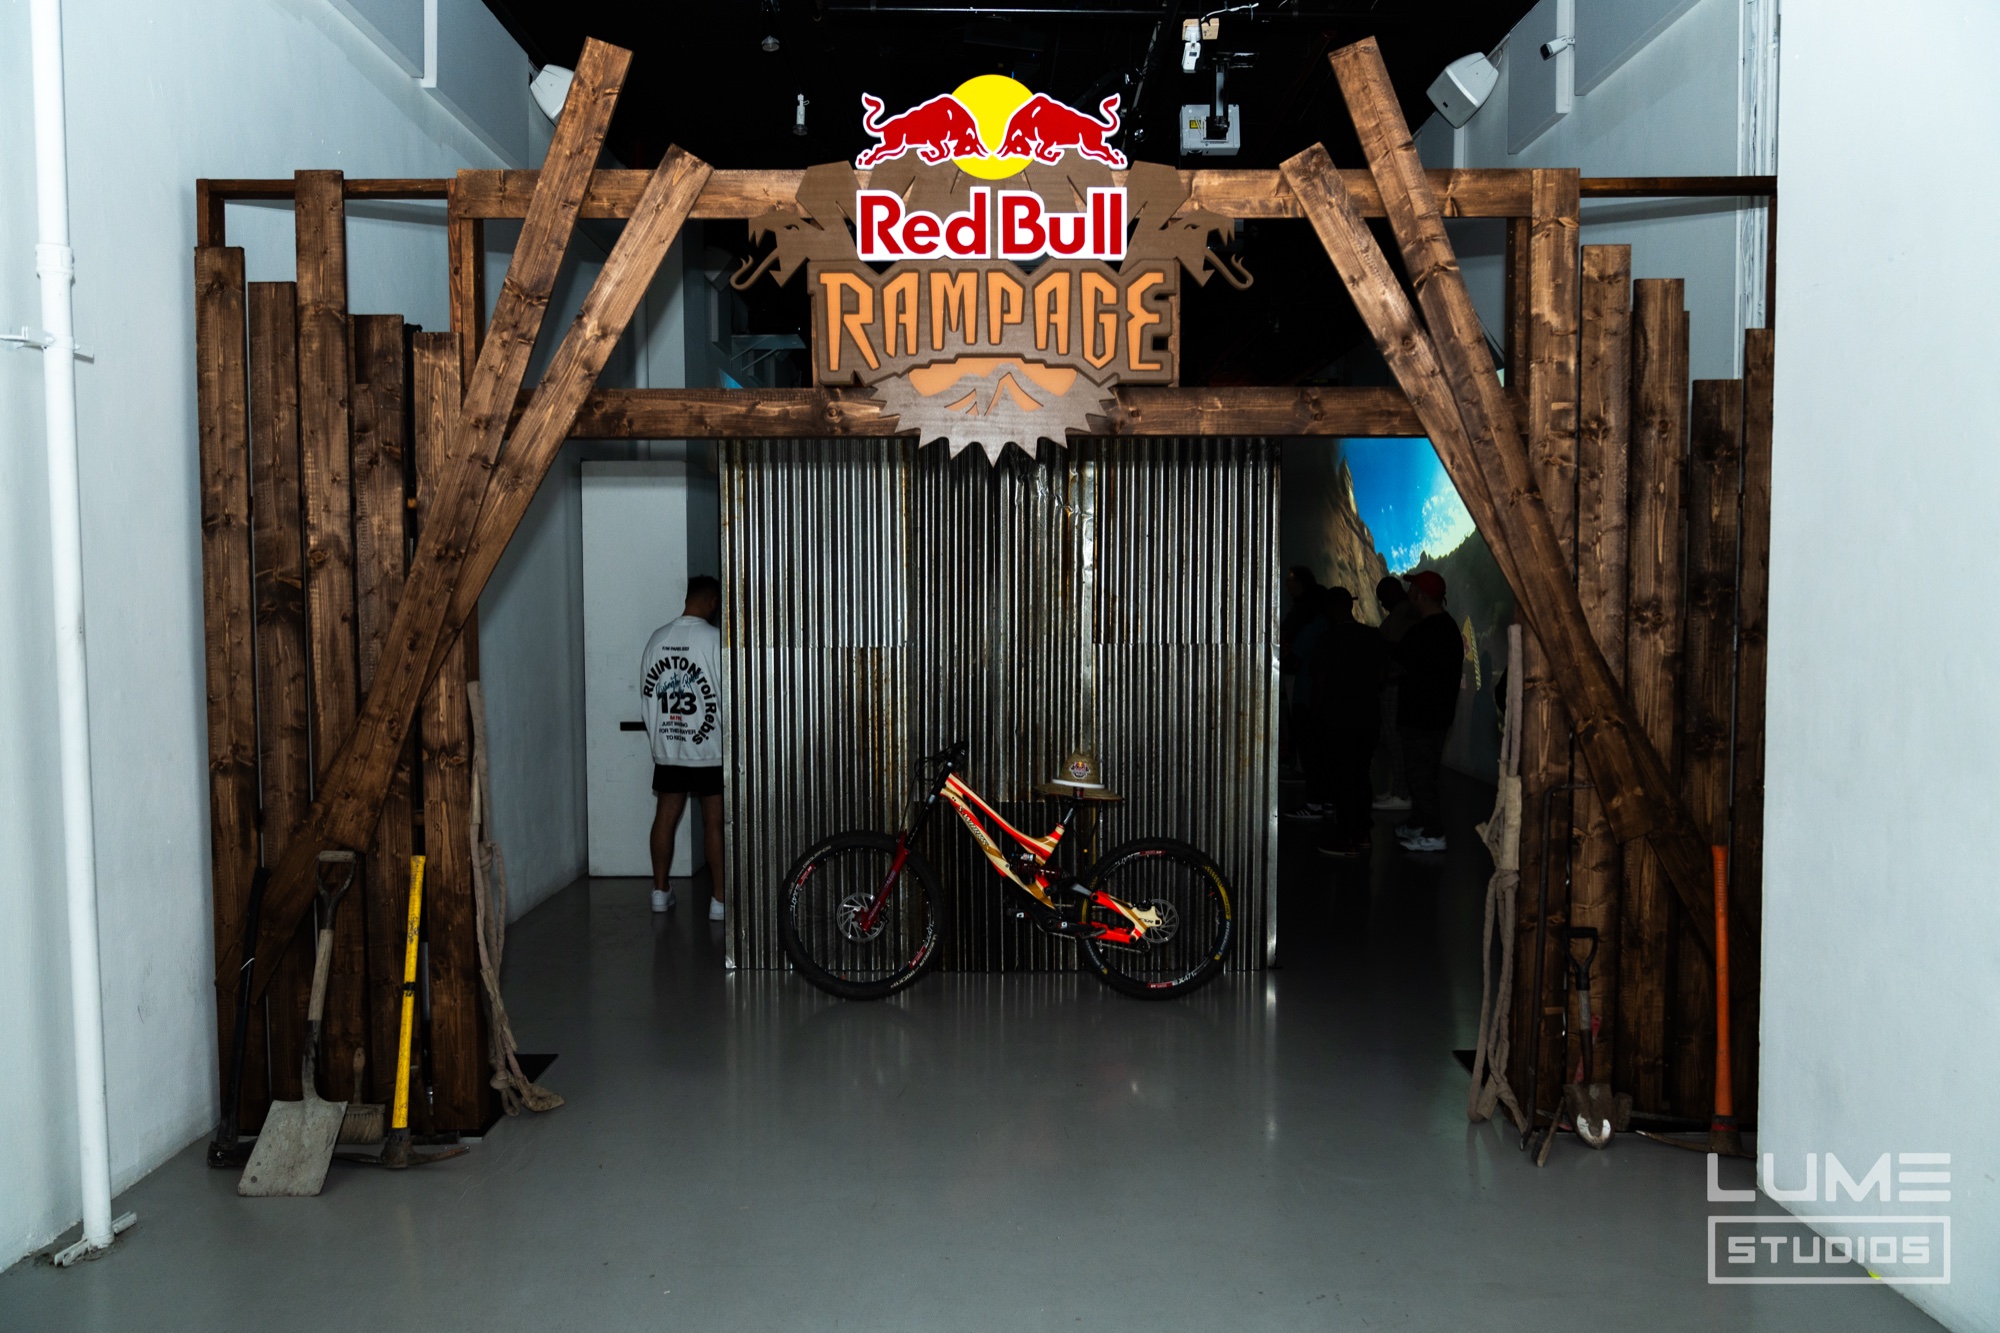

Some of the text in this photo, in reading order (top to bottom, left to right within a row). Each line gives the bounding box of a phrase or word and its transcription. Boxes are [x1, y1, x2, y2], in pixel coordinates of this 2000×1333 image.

[860, 192, 1122, 255] Red Bull
[819, 271, 1164, 372] RAMPAGE
[657, 691, 697, 716] 123
